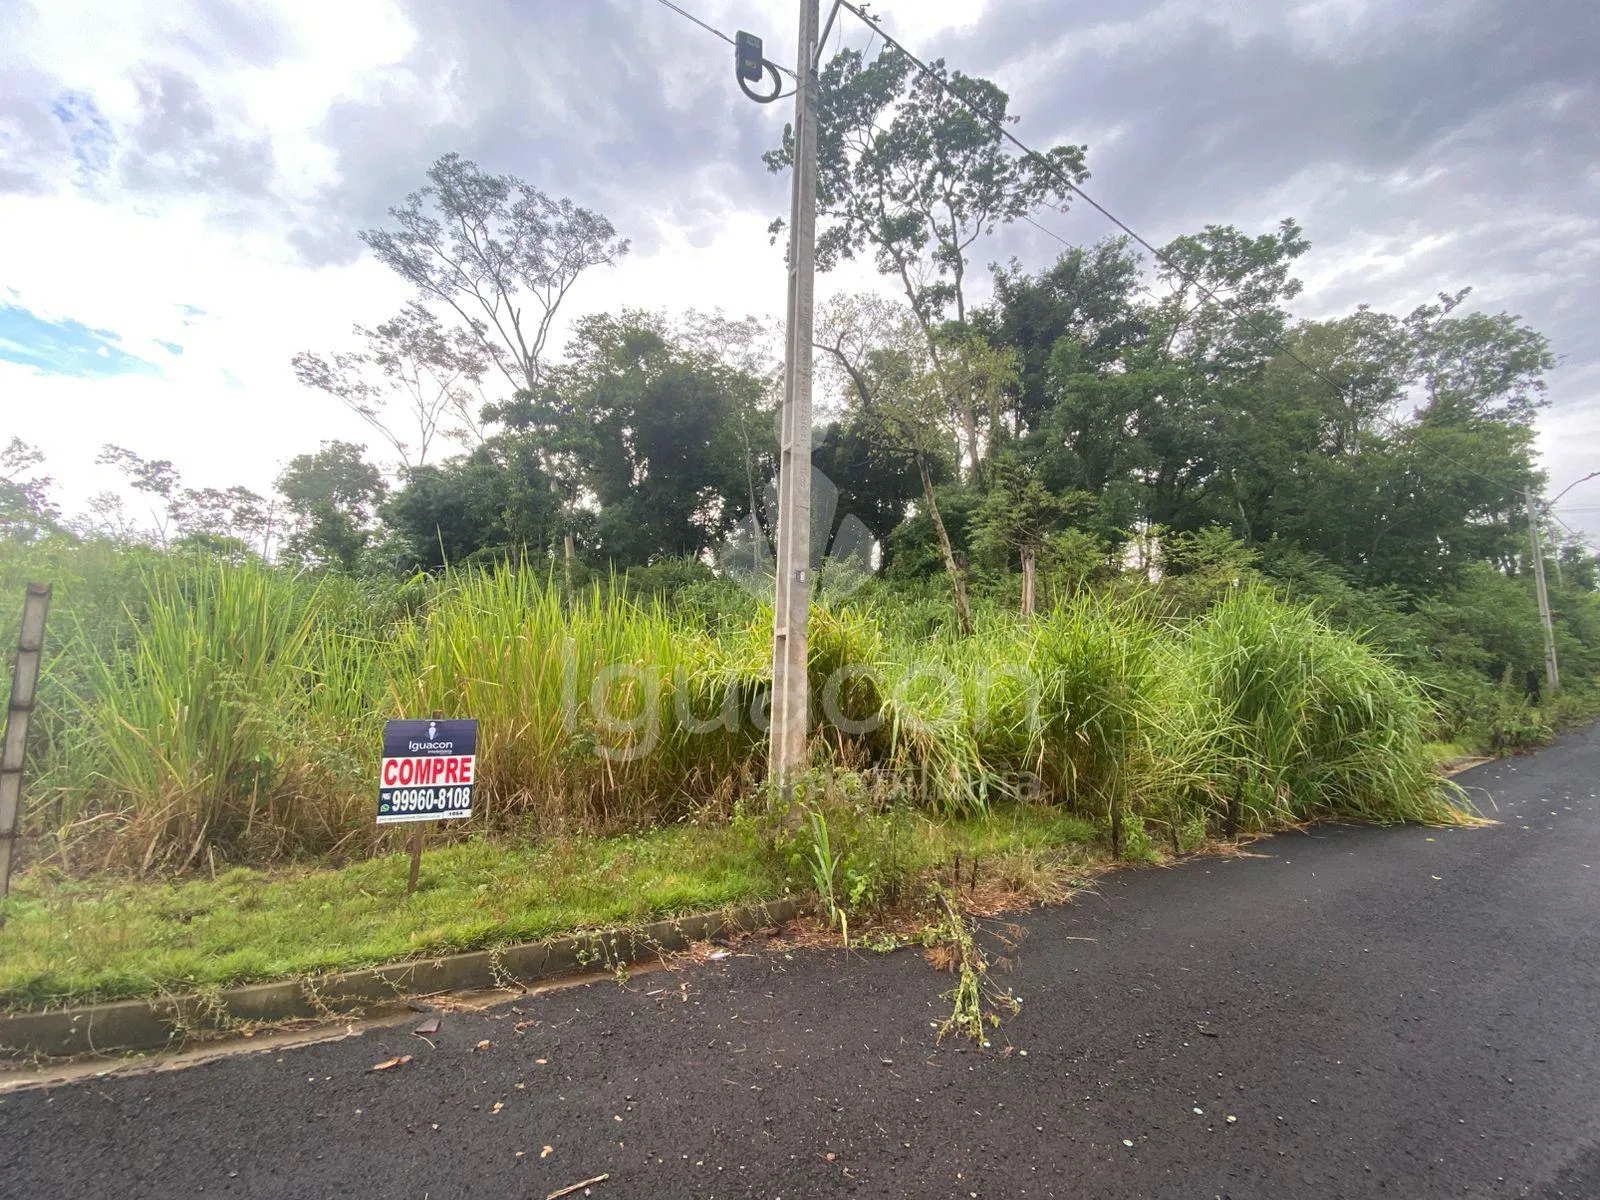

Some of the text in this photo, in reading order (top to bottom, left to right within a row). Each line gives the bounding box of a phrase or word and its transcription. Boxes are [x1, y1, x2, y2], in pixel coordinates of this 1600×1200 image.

[408, 741, 453, 751] Iguacon
[384, 758, 472, 785] COMPRE
[392, 788, 470, 811] 99960-8108
